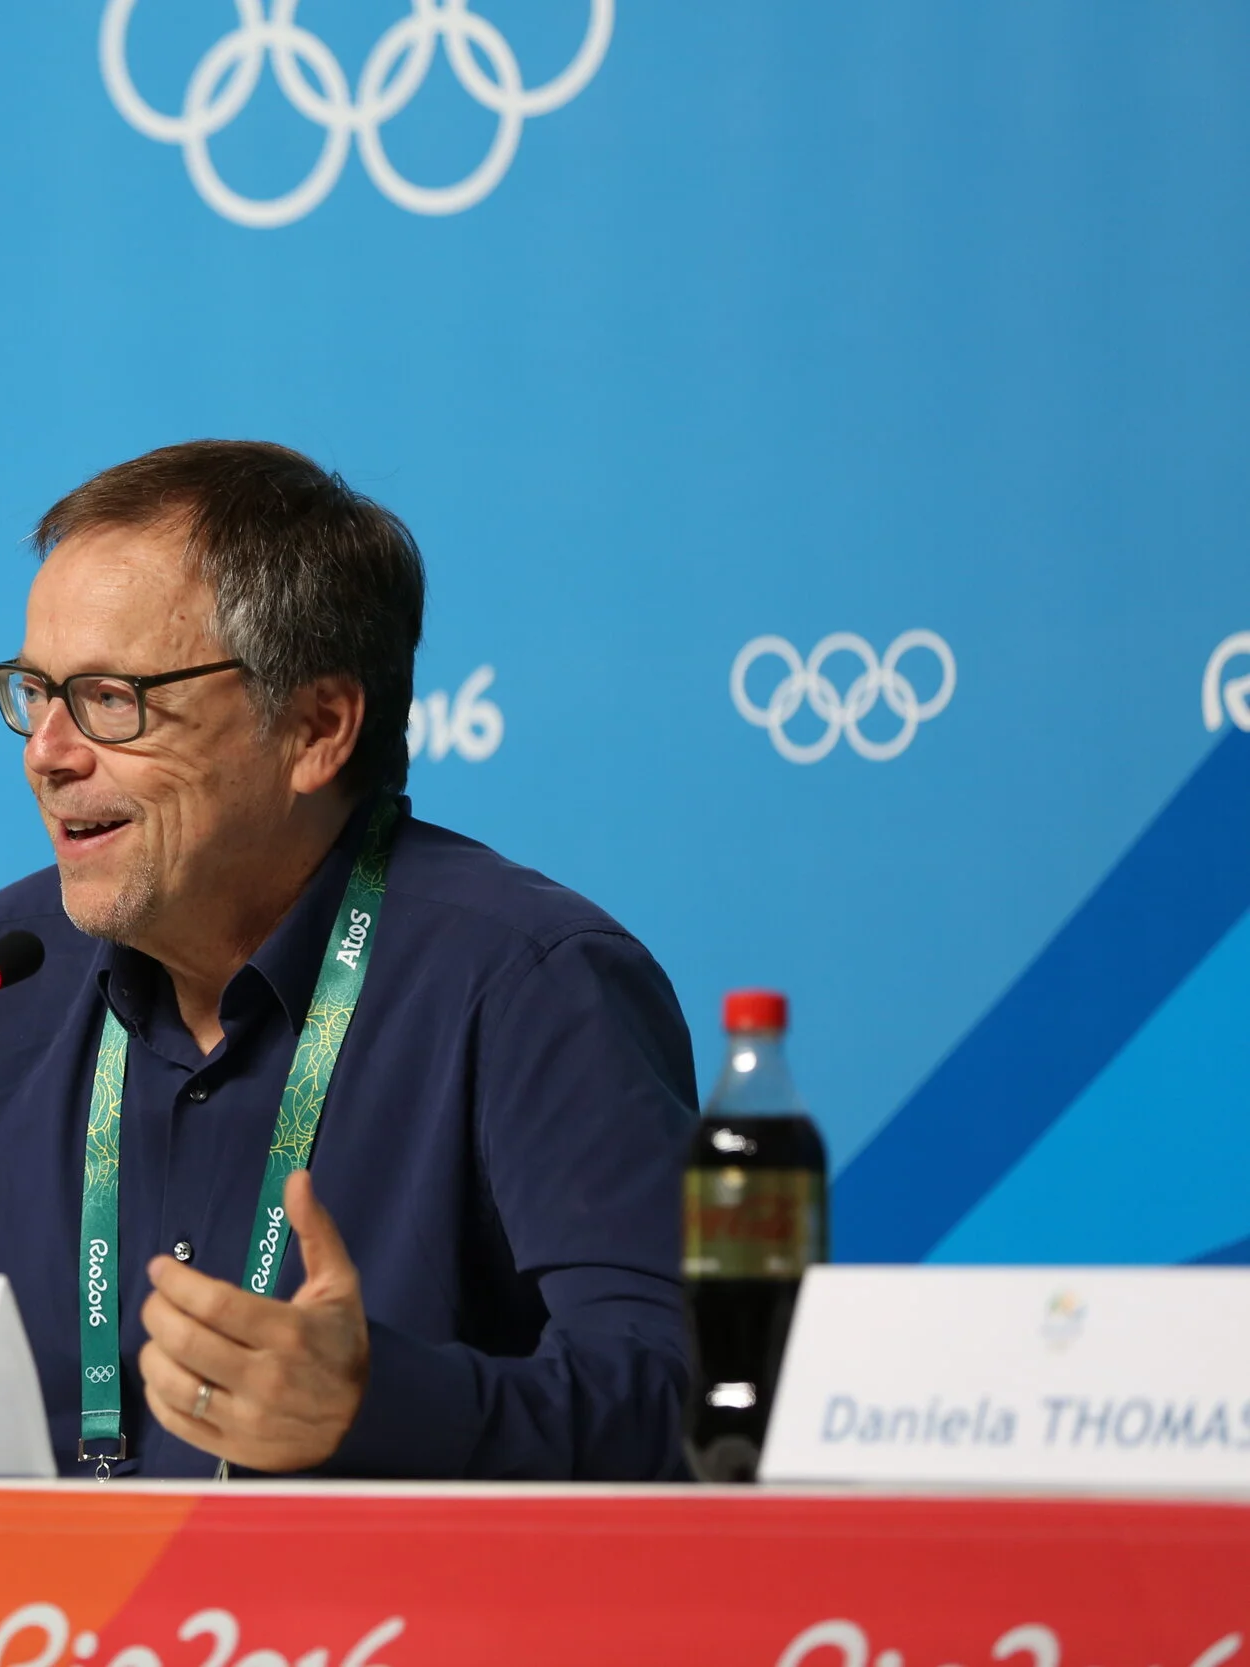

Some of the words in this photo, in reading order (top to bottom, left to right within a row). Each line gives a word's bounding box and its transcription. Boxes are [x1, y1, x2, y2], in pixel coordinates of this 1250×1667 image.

[336, 908, 371, 970] Atos
[88, 1239, 108, 1327] Rio2016
[251, 1206, 284, 1293] Rio2016
[820, 1395, 1016, 1445] Daniela
